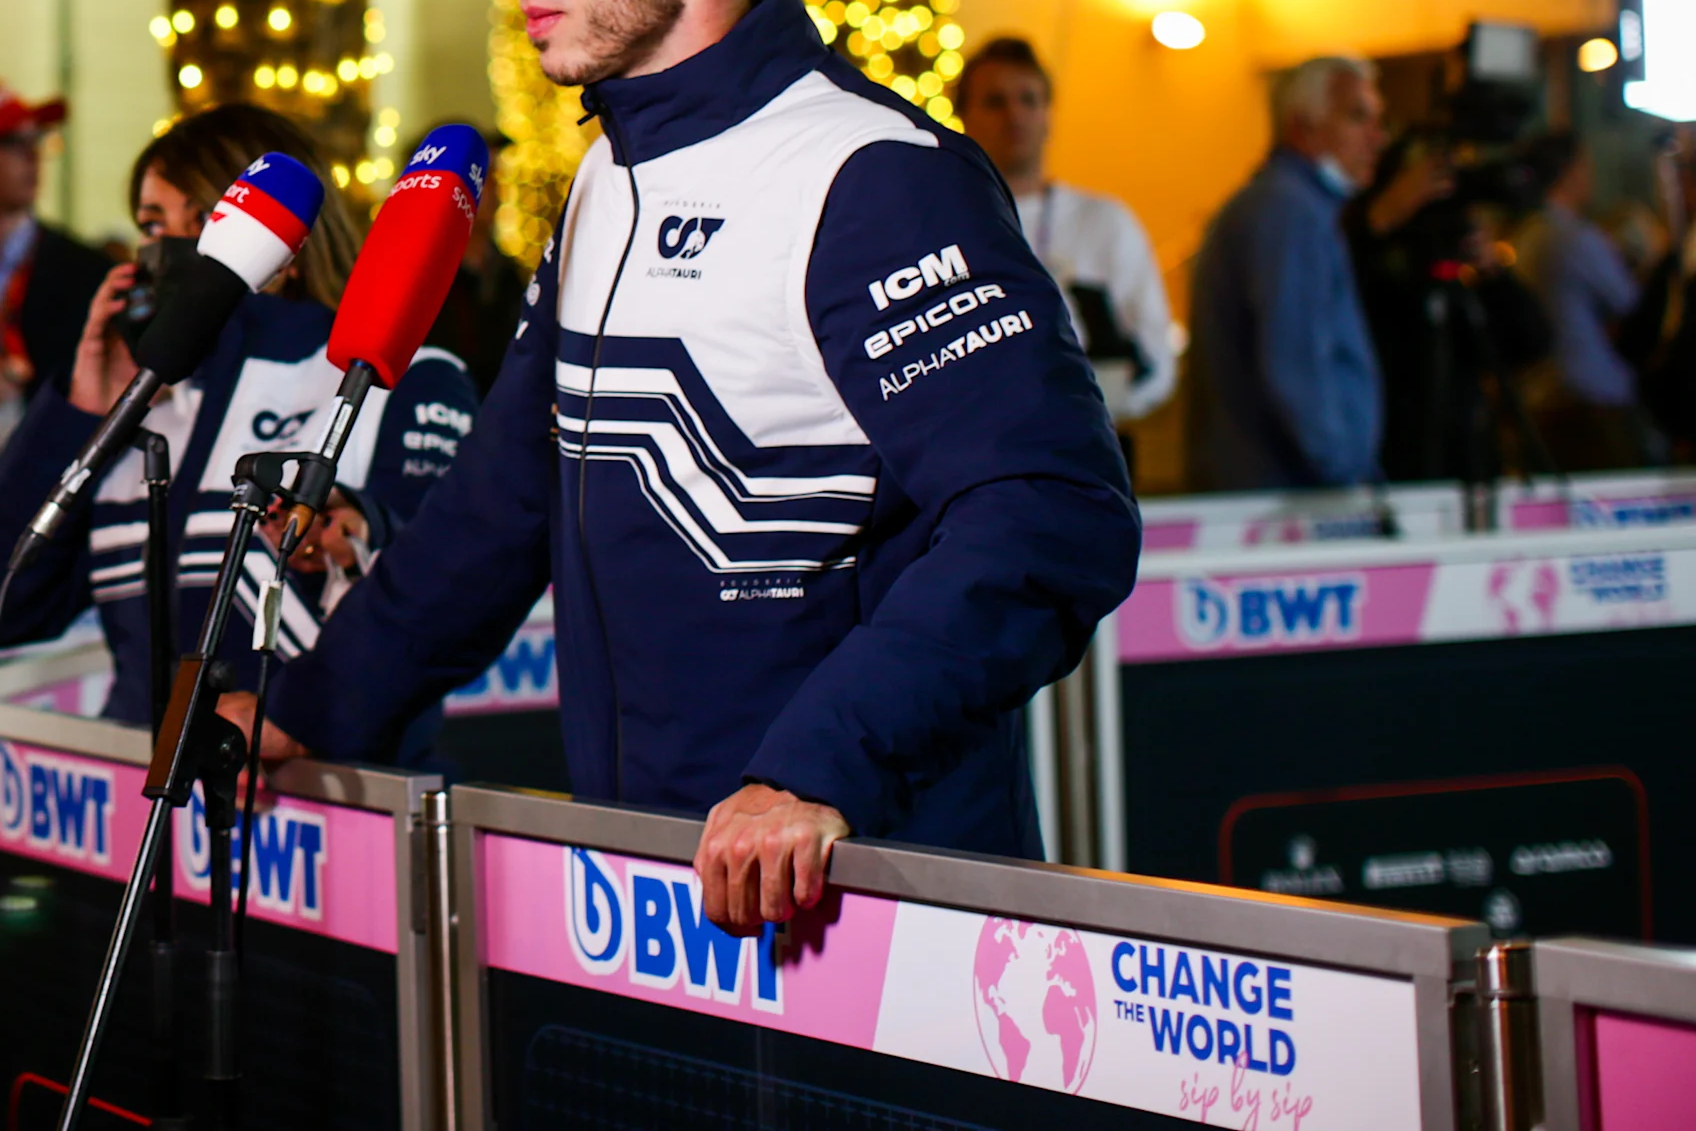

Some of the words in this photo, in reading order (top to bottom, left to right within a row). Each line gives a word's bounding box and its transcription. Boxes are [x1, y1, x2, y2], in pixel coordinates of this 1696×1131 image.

[389, 174, 442, 197] ports
[409, 144, 447, 166] sky
[645, 266, 702, 280] ALPHATAURI
[868, 244, 969, 311] ICM
[879, 310, 1033, 401] ALPHATAURI
[1239, 583, 1359, 638] BWT
[29, 762, 110, 857] BWT
[1111, 941, 1293, 1021] CHANGE
[1113, 999, 1145, 1023] THE
[1148, 1005, 1296, 1076] WORLD
[1179, 1072, 1219, 1125] sip
[1230, 1050, 1261, 1131] by
[1269, 1081, 1313, 1131] sip
